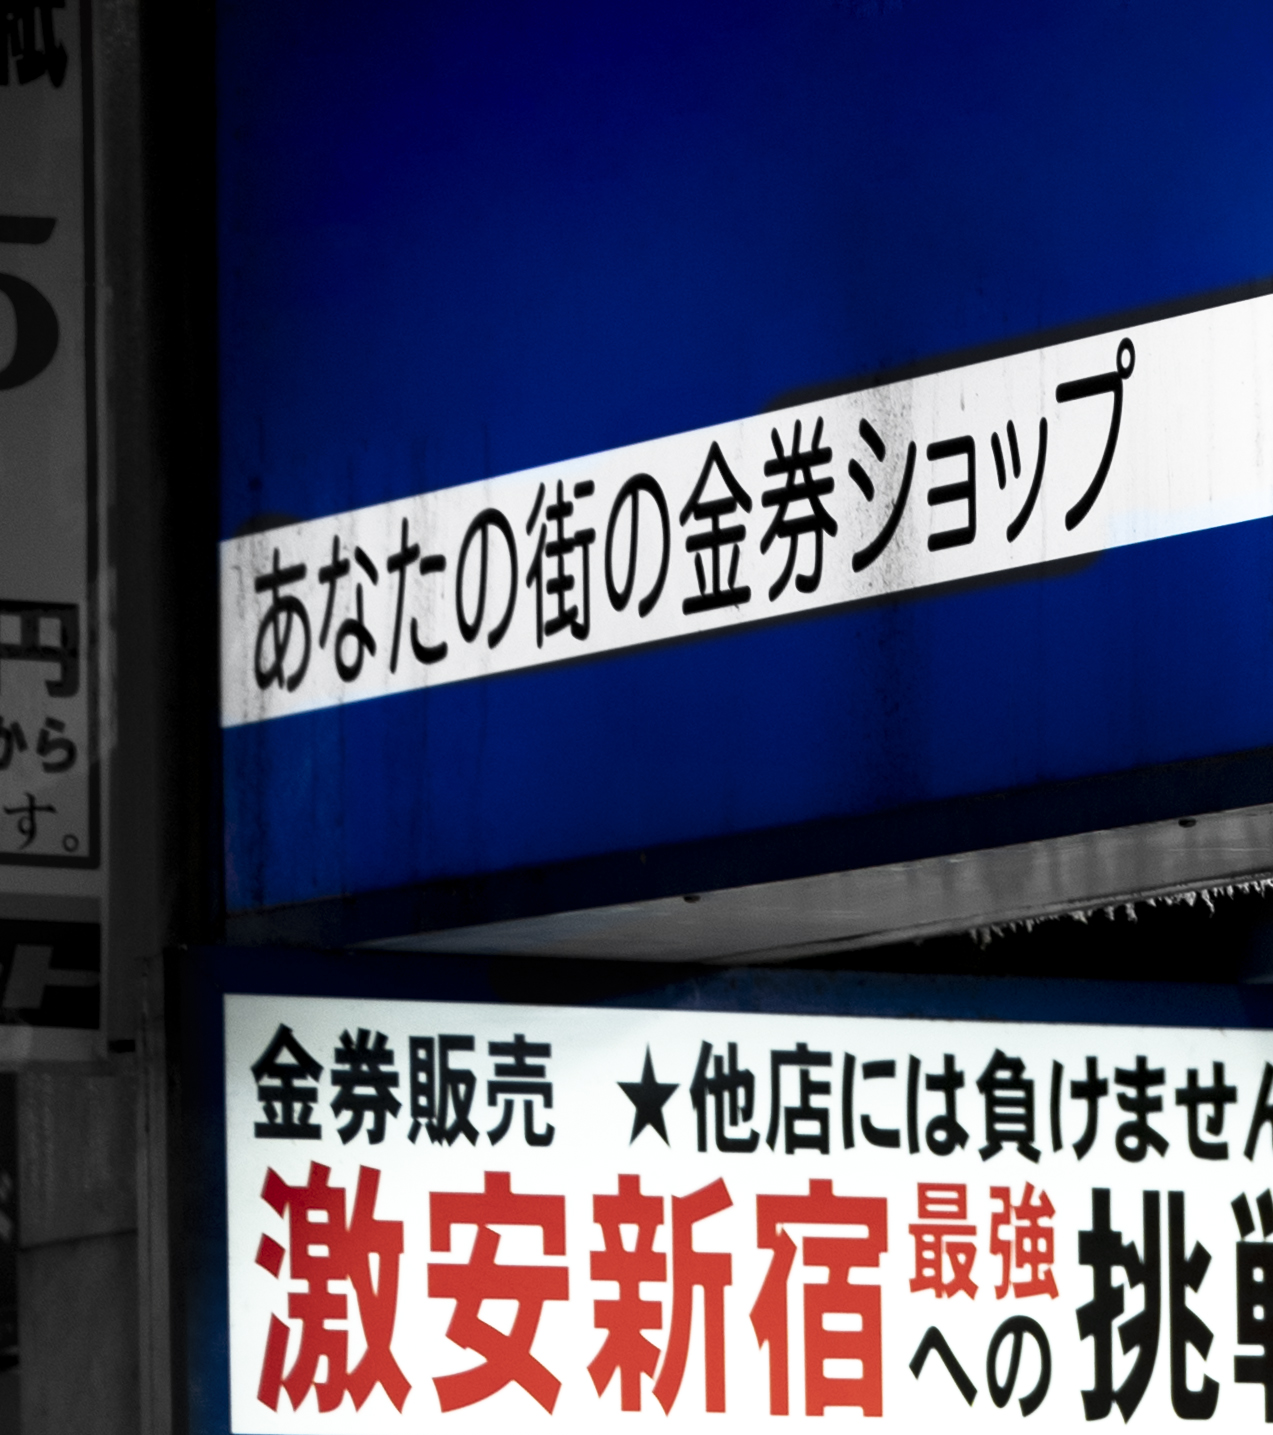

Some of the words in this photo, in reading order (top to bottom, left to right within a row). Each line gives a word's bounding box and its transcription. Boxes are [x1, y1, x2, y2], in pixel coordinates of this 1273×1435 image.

[252, 336, 1138, 696] あなたの街の金券ショップ
[248, 1022, 559, 1147] 金券販売
[253, 1159, 892, 1418] 激安新宿
[907, 1181, 1061, 1301] 最強
[907, 1313, 1056, 1417] への
